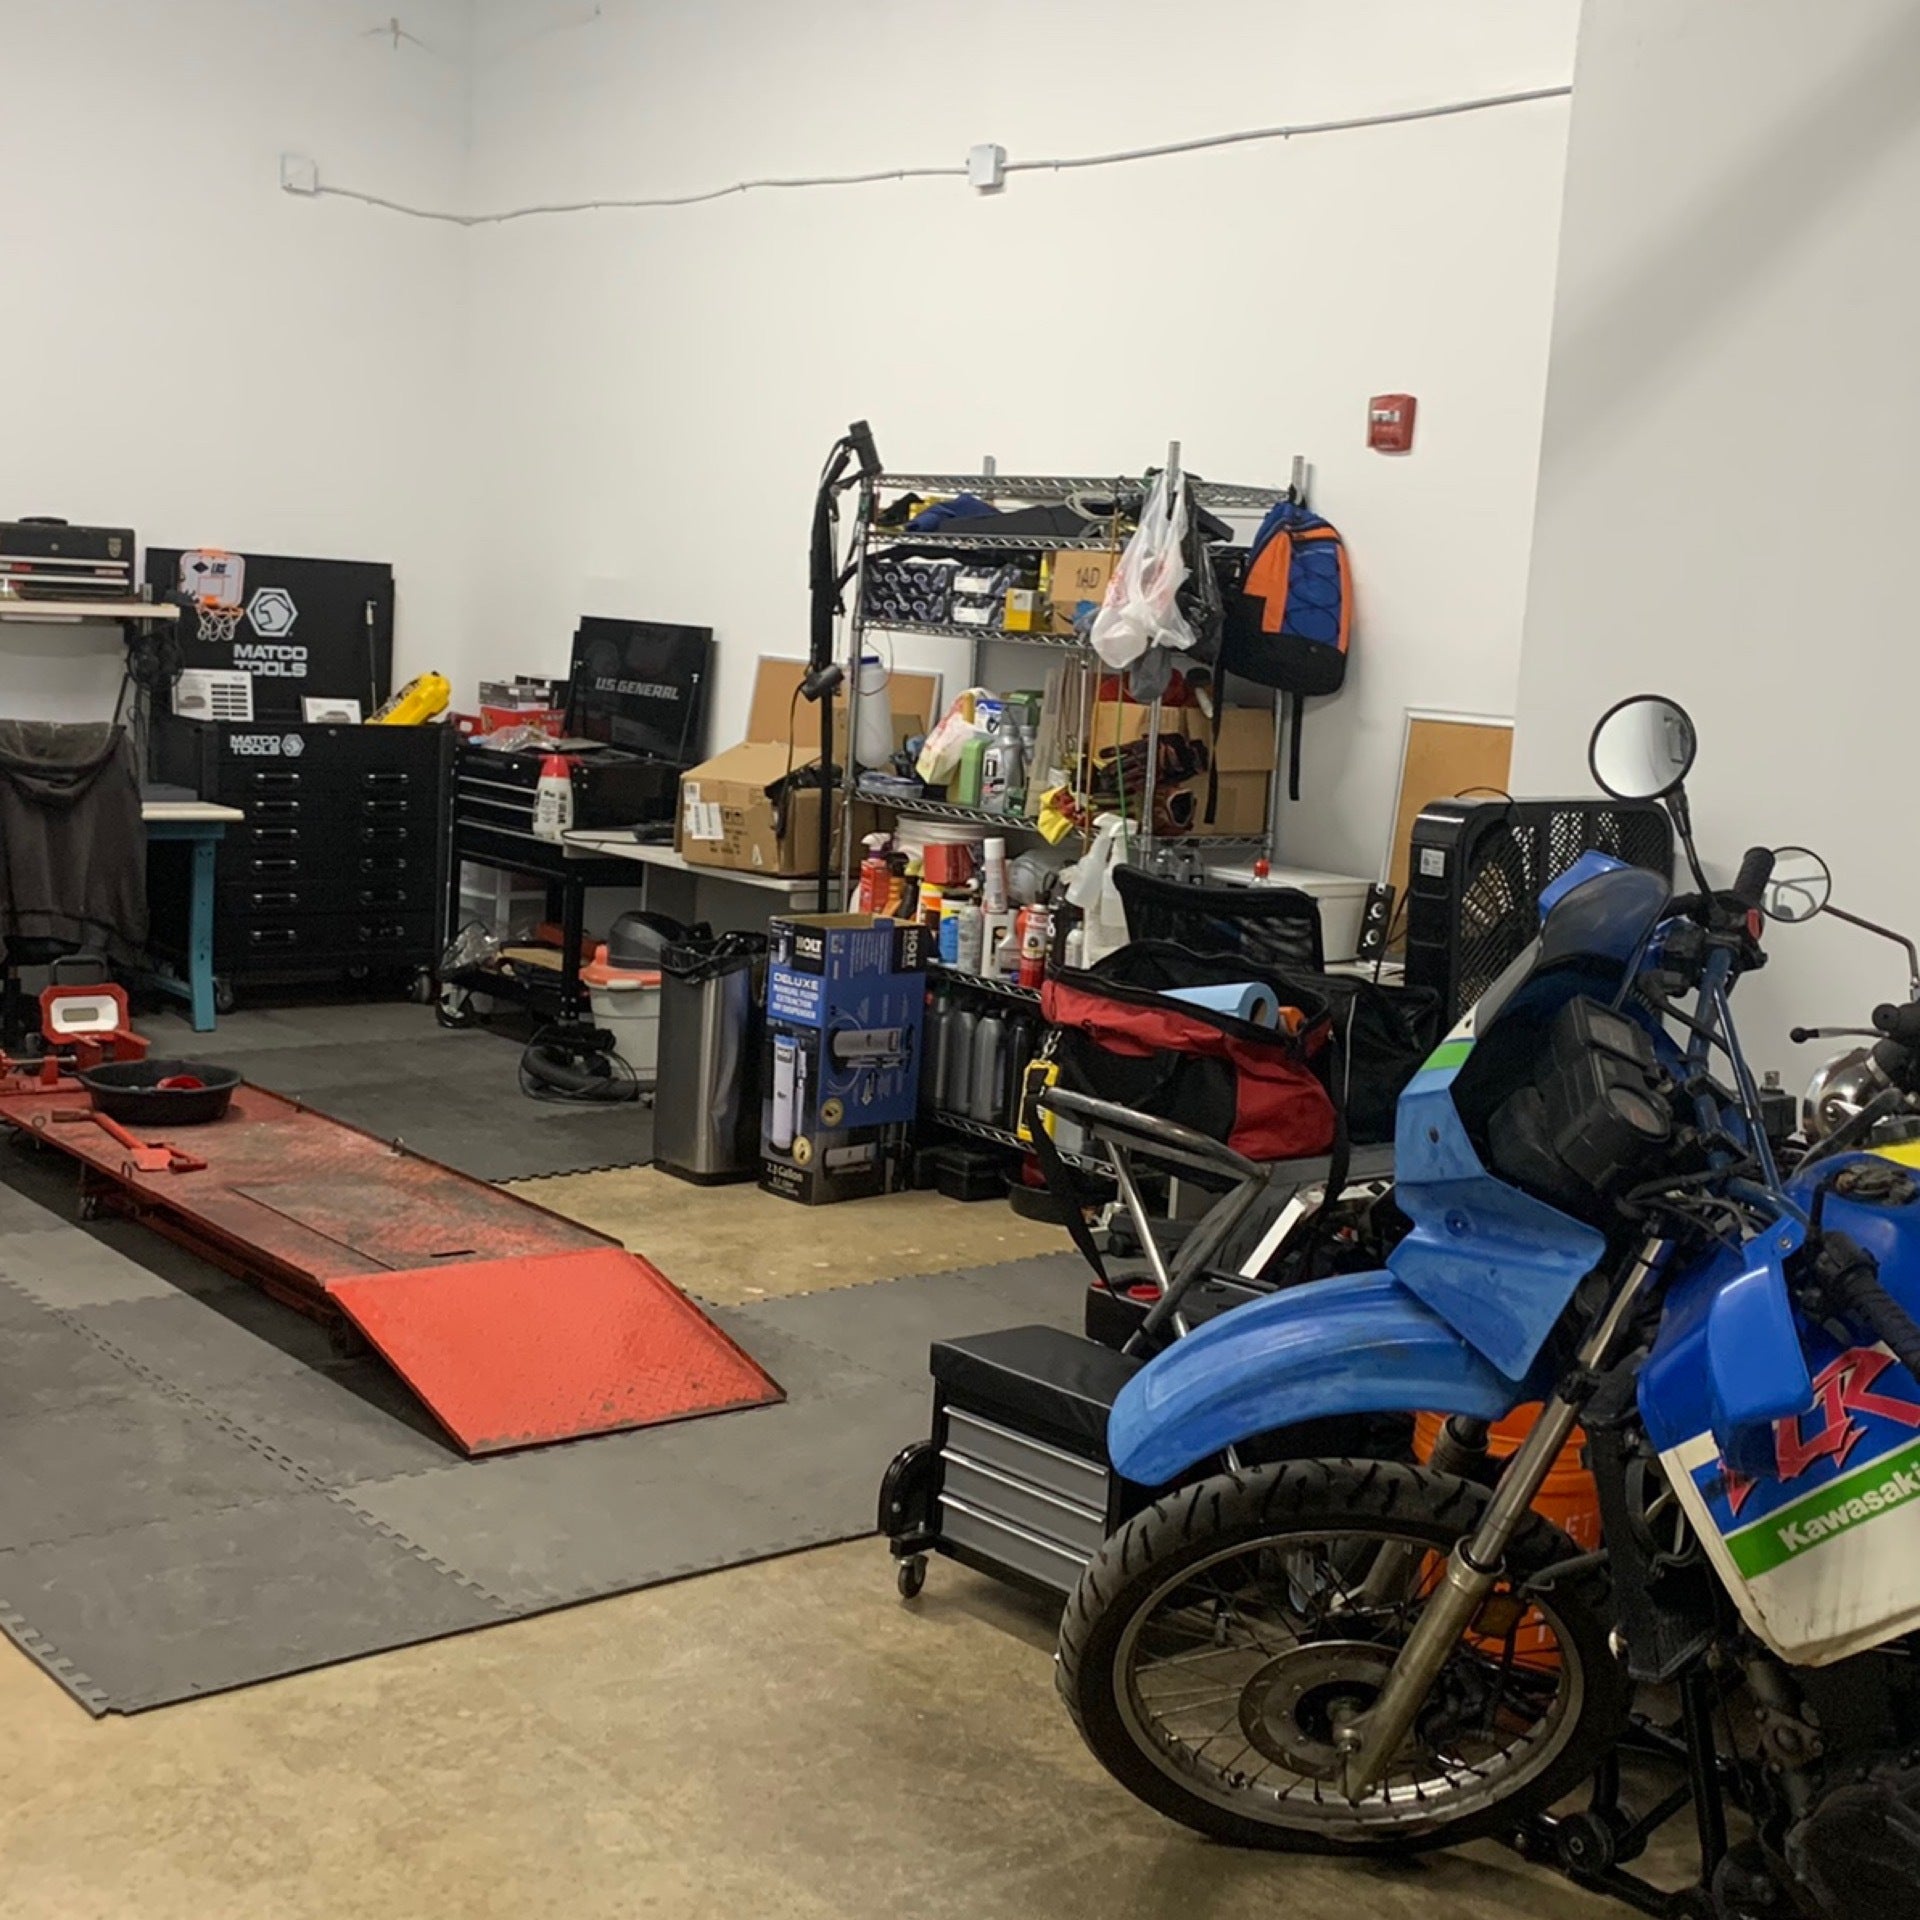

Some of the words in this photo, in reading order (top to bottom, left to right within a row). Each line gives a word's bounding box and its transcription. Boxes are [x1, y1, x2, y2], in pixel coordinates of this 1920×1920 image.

[233, 644, 307, 660] MATCO
[233, 660, 307, 677] TOOLS
[617, 680, 679, 700] GENERAL
[230, 735, 280, 749] MATCO
[232, 744, 280, 755] TOOLS
[773, 972, 819, 991] DELUXE
